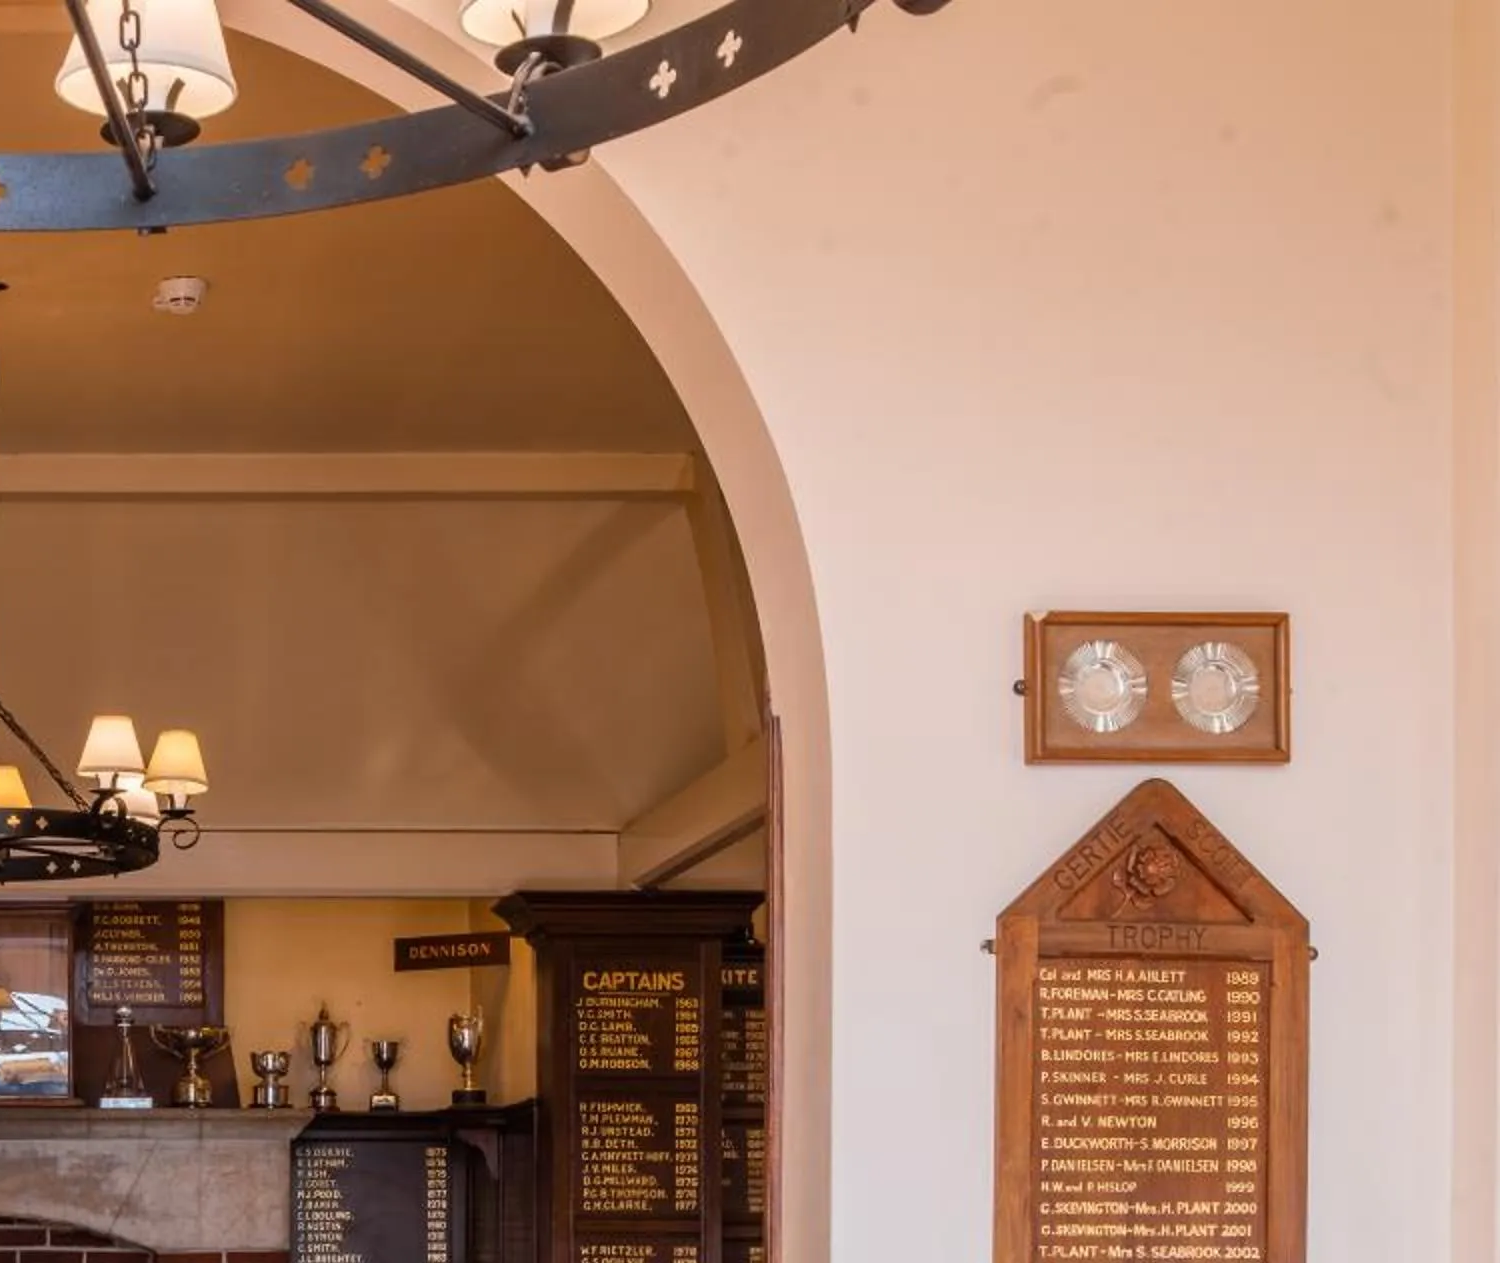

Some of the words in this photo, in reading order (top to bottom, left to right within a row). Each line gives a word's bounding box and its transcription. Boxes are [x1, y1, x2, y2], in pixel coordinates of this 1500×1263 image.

[1054, 807, 1136, 892] GERTIE
[1185, 821, 1252, 890] SCOTT
[1107, 925, 1208, 951] TROPHY
[409, 942, 491, 959] DENNISON
[583, 972, 685, 990] CAPTAINS
[1087, 970, 1111, 981] MRS
[1227, 972, 1259, 985] 1989
[1227, 992, 1260, 1004] 1990
[1227, 1011, 1257, 1023] 1991
[1227, 1030, 1259, 1043] 1992
[1124, 1073, 1149, 1084] MRS
[1169, 1073, 1208, 1084] CURLE
[1227, 1073, 1259, 1084] 1994
[1227, 1096, 1259, 1107] 1995
[1097, 1116, 1157, 1128] NEWTON
[1227, 1117, 1259, 1129] 1996
[1227, 1137, 1258, 1150] 1997
[1227, 1161, 1256, 1172] 1998
[1226, 1182, 1255, 1193] 1999
[1224, 1202, 1257, 1214] 2000
[1221, 1224, 1252, 1237] 2001
[1152, 1247, 1221, 1259] SEABROOK
[1224, 1247, 1260, 1259] 2002
